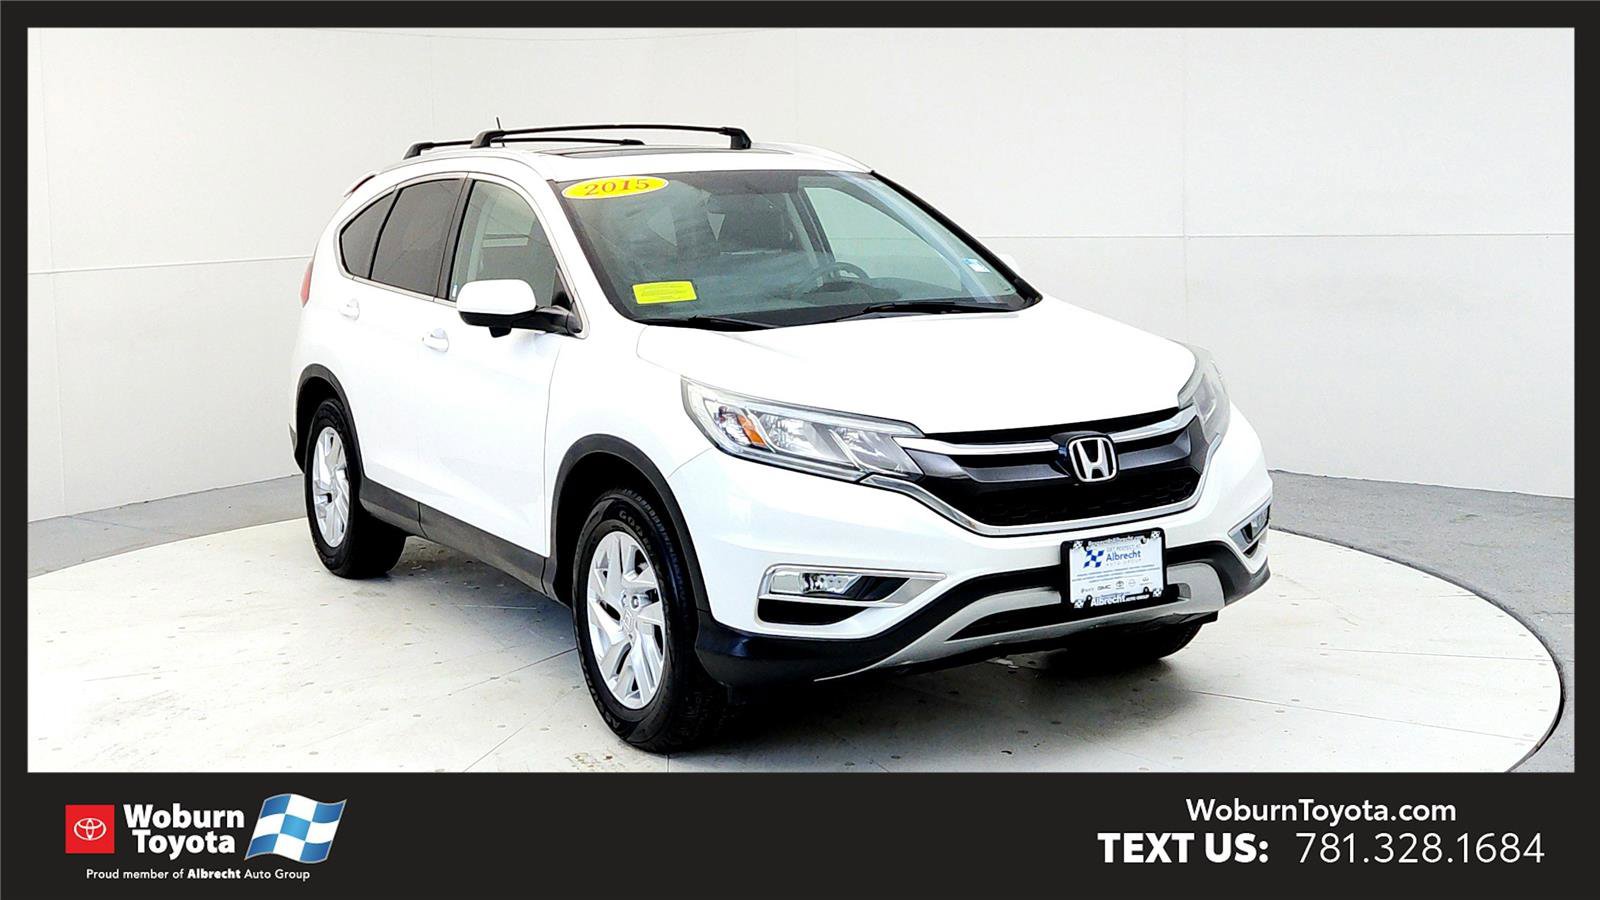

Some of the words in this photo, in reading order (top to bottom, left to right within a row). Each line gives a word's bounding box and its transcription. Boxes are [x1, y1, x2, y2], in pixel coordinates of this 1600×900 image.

[585, 178, 650, 196] 2015
[1106, 550, 1141, 561] Albrecht
[1091, 595, 1126, 607] Albrecht
